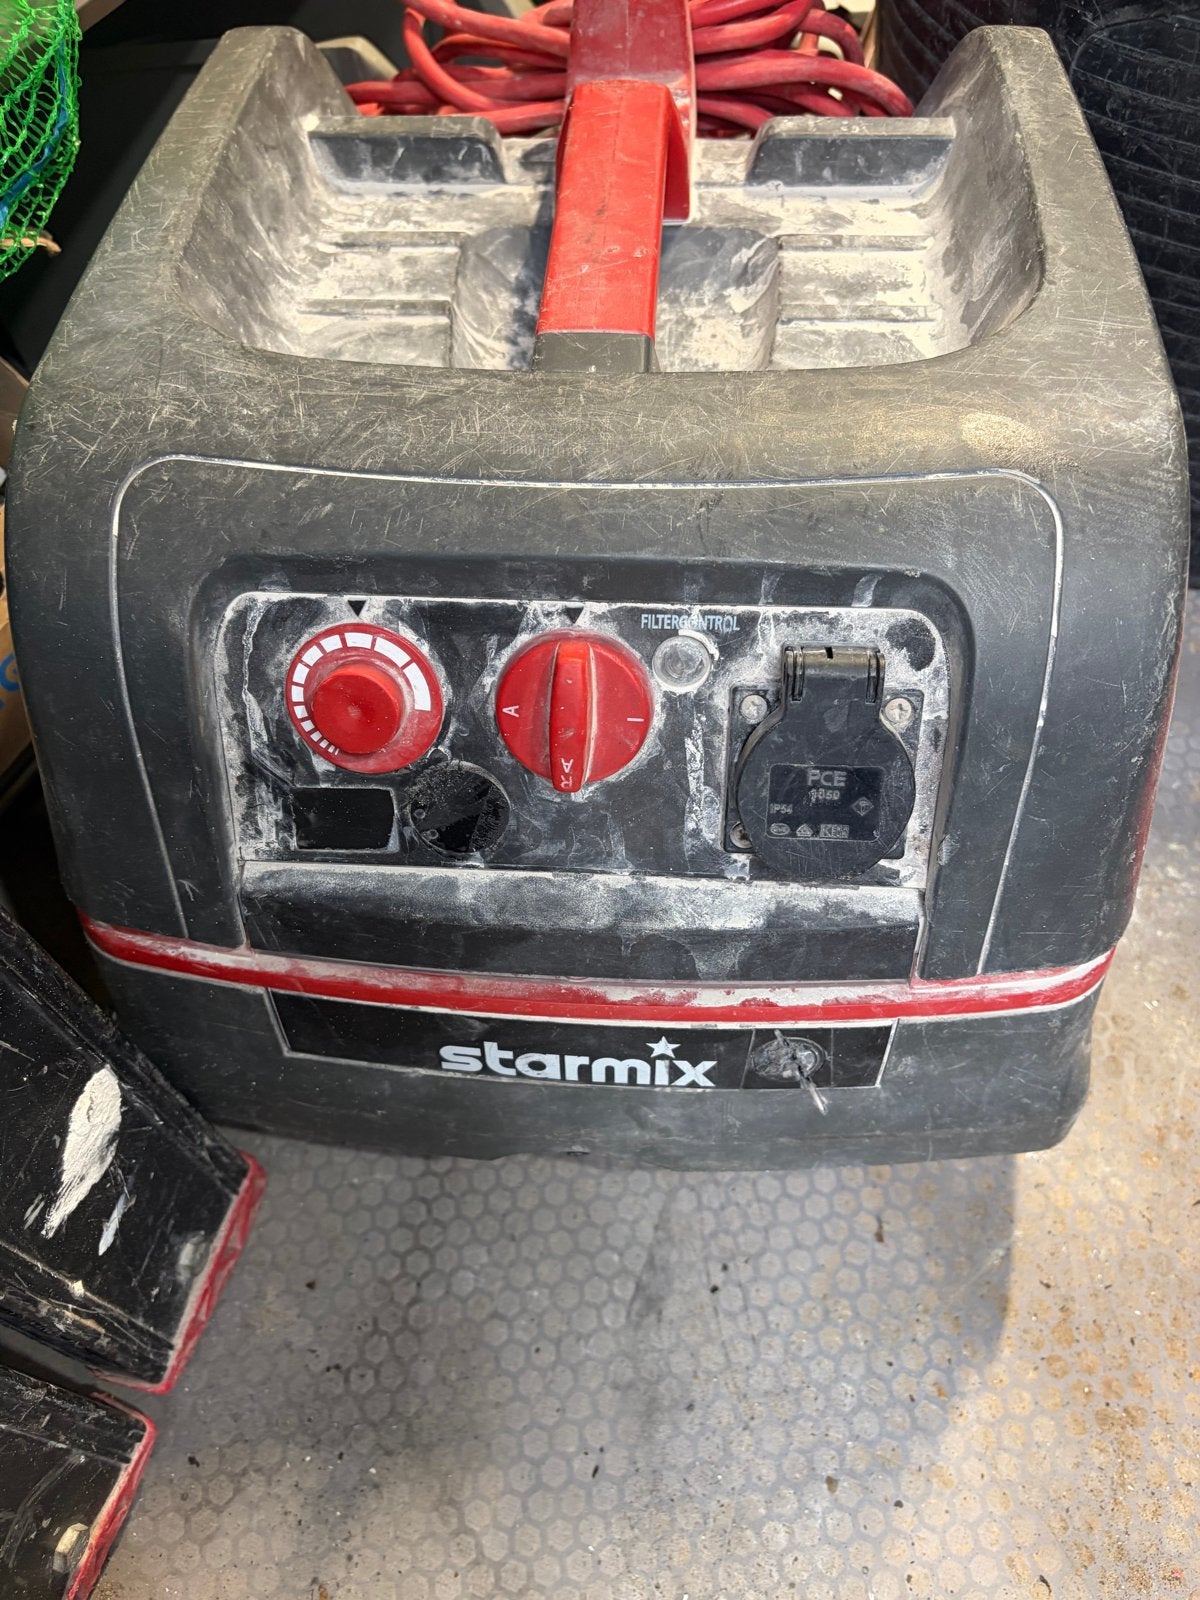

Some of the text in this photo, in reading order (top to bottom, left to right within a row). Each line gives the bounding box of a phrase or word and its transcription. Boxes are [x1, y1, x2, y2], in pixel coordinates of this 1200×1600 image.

[641, 613, 741, 633] FILTERCONTROL
[502, 705, 519, 718] A
[807, 769, 847, 787] PCE
[439, 1035, 718, 1087] starmix
